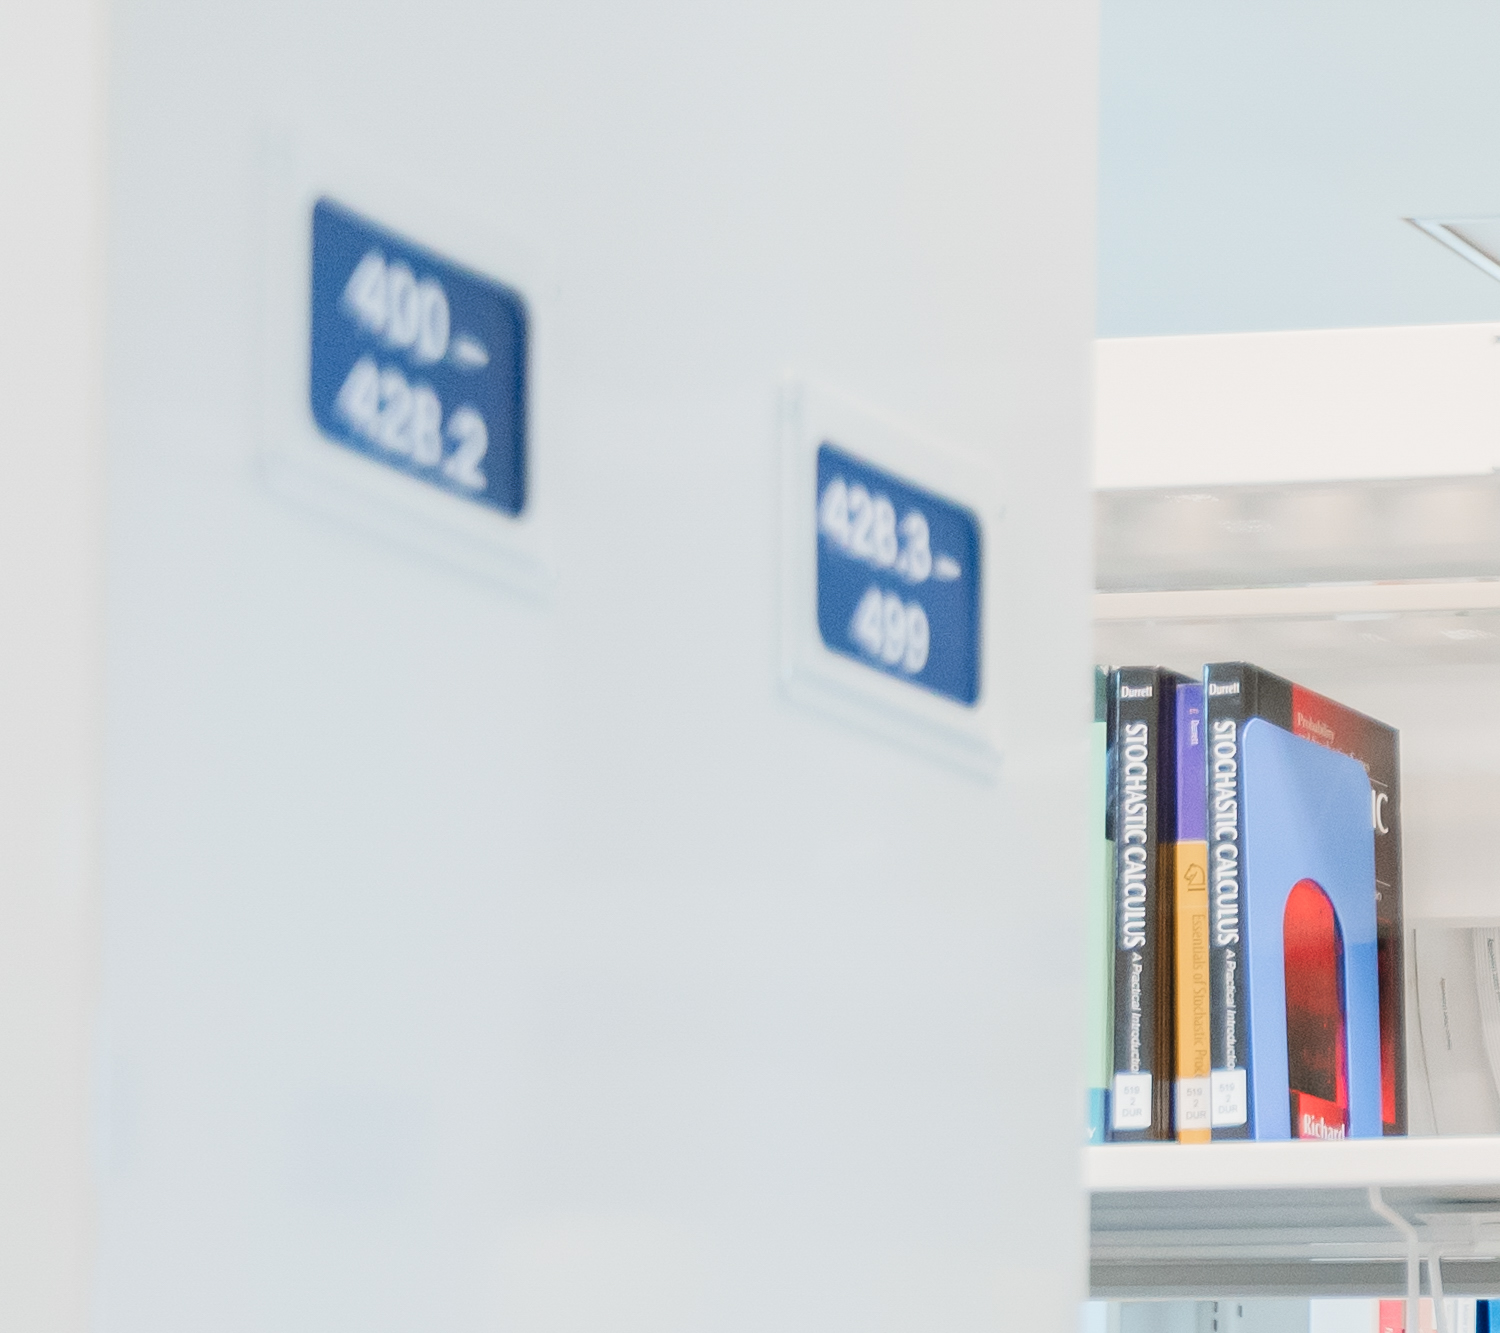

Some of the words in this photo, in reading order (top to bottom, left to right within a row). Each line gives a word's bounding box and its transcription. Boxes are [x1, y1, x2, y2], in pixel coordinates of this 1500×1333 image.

[337, 354, 491, 492] 428.2
[852, 587, 931, 675] 499
[1124, 723, 1149, 844] STOCHASTIC
[1213, 720, 1237, 841] STOCHASTIC
[1123, 847, 1147, 950] CALCULUS
[1216, 843, 1240, 947] CALCULUS
[1131, 952, 1143, 962] A
[1131, 963, 1143, 1011] Practical
[1193, 974, 1207, 985] of
[1226, 961, 1237, 1009] Practical
[1193, 985, 1208, 1045] Stochastic
[1130, 1012, 1142, 1075] Introductio
[1226, 1009, 1237, 1071] Introductio
[1123, 1085, 1140, 1095] 519
[1186, 1088, 1203, 1097] 519
[1219, 1083, 1235, 1092] 519
[1225, 1095, 1231, 1103] 2
[1121, 1108, 1143, 1117] DUR
[1130, 1097, 1135, 1106] 2
[1193, 1099, 1198, 1108] 2
[1218, 1104, 1238, 1114] DUR
[1186, 1111, 1207, 1120] DUR
[1303, 1113, 1345, 1139] Richard
